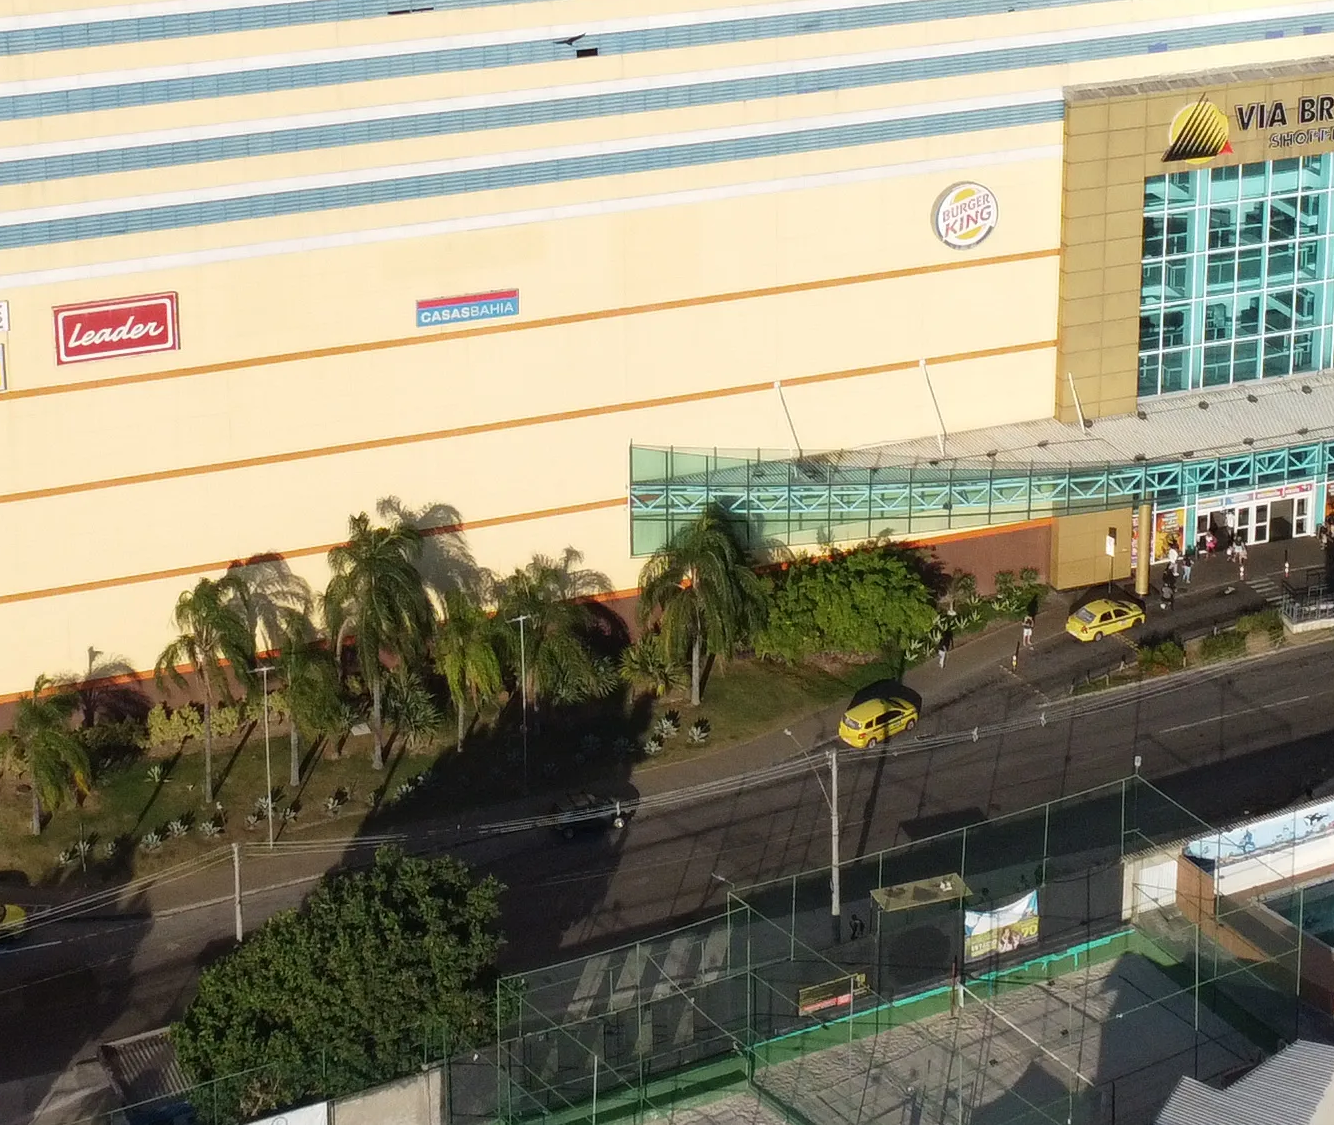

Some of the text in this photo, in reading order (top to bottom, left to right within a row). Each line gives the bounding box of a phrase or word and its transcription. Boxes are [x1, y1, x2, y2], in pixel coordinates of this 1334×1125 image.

[1234, 102, 1287, 131] VIA
[942, 193, 990, 222] BURGER
[944, 205, 991, 238] KING
[68, 314, 165, 348] Leader
